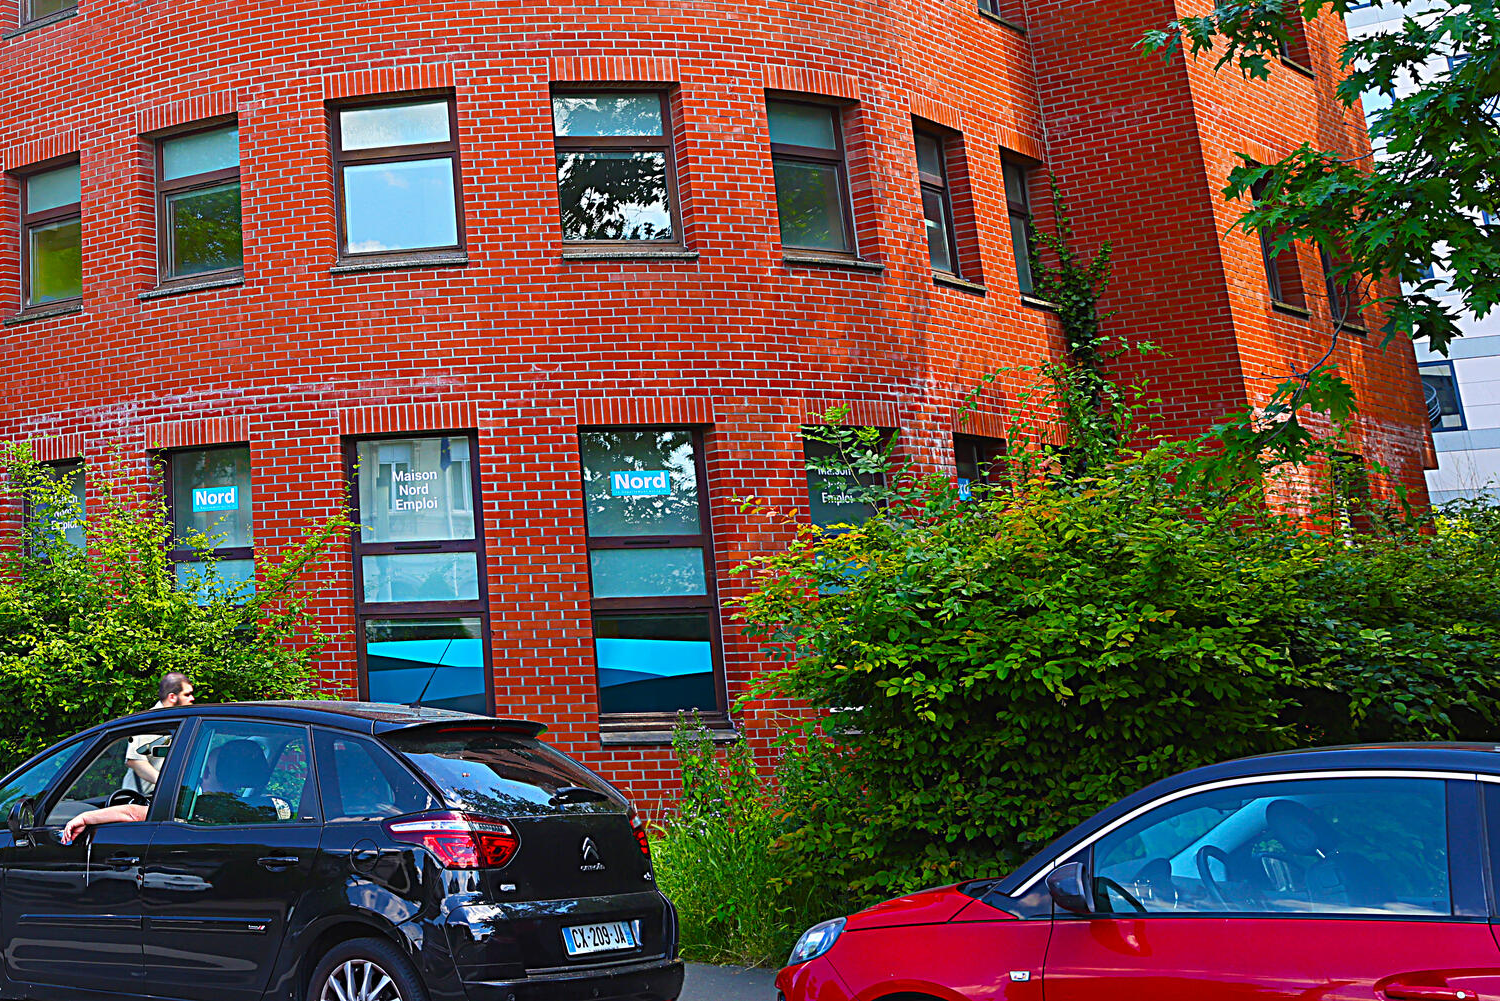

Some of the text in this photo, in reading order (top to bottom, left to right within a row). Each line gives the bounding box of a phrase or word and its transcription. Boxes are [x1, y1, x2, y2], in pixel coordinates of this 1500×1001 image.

[391, 469, 438, 482] Maison
[614, 471, 667, 490] Nord
[195, 487, 235, 506] Nord
[399, 483, 429, 496] Nord
[395, 496, 438, 512] Emploi
[571, 922, 627, 949] CX-209-JA
